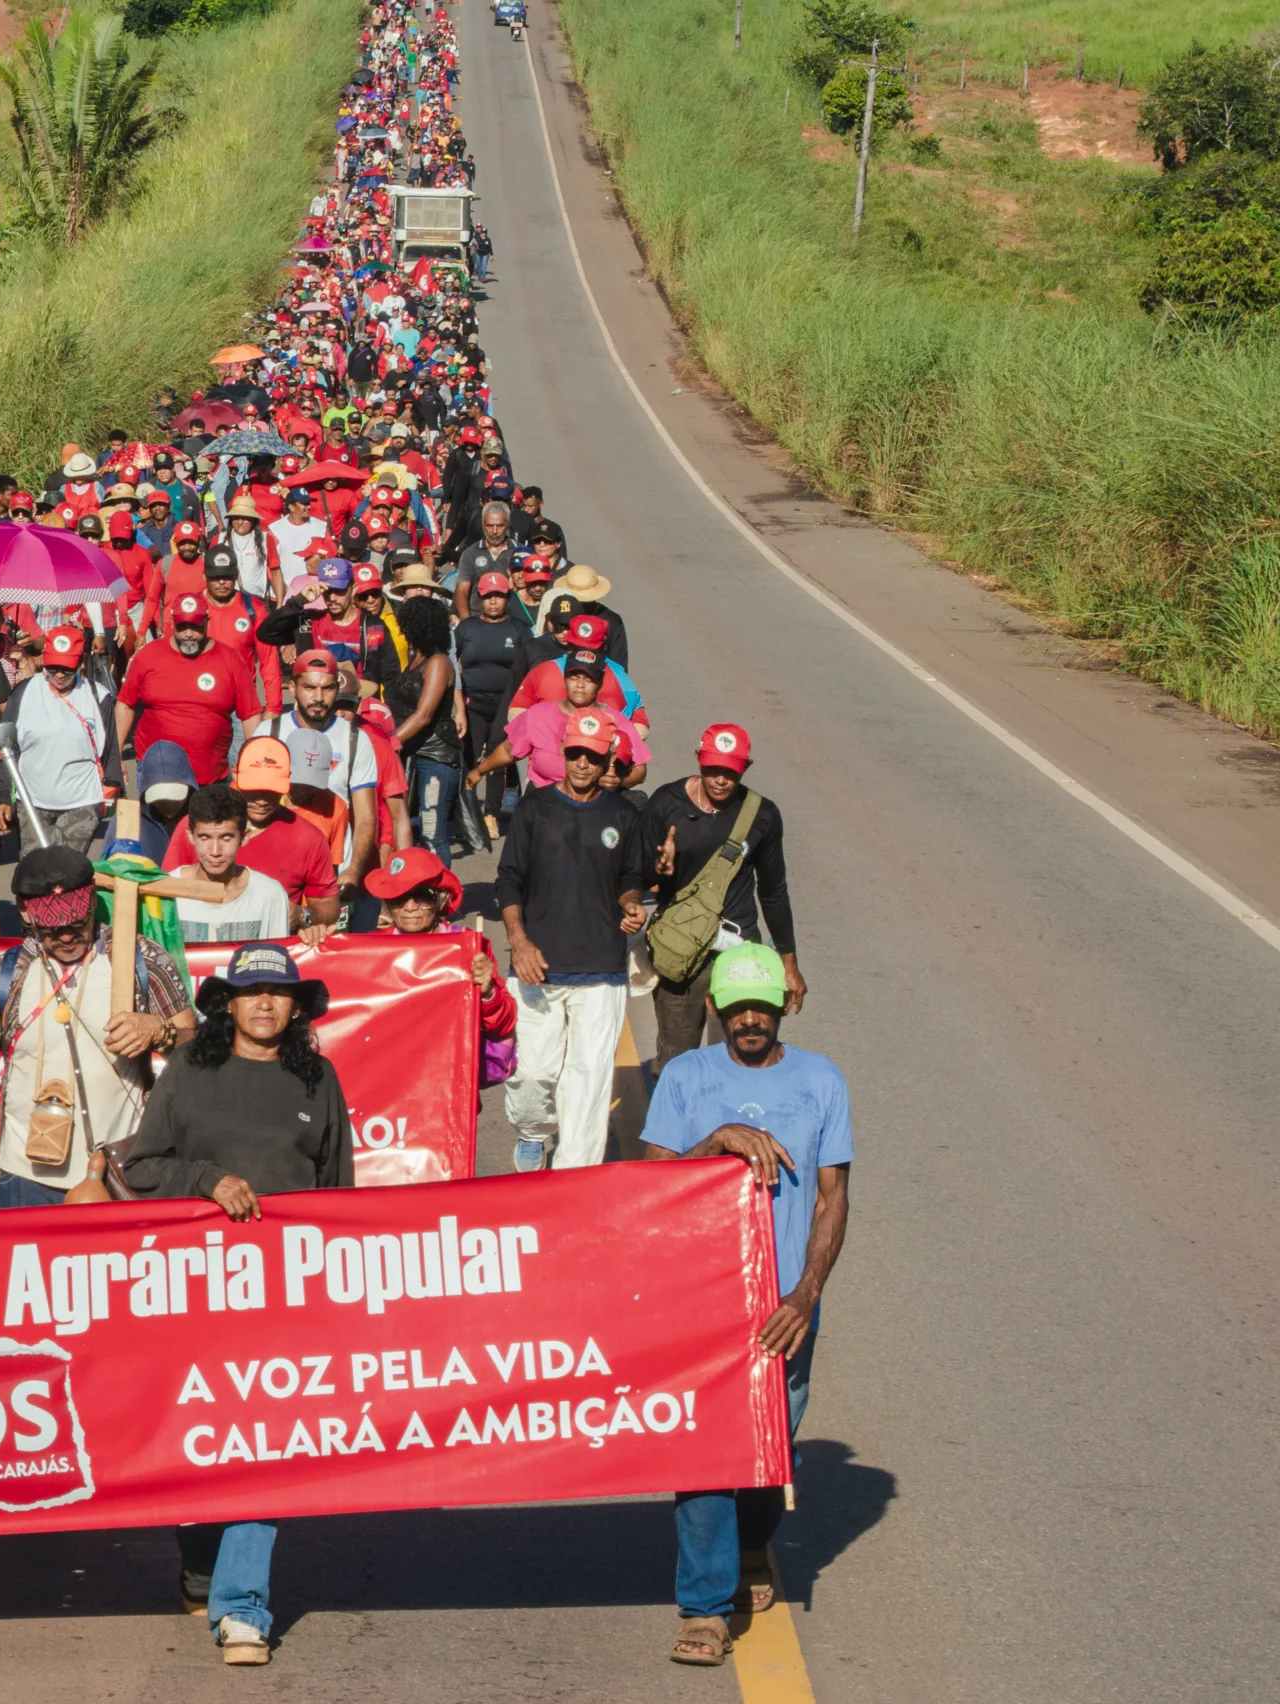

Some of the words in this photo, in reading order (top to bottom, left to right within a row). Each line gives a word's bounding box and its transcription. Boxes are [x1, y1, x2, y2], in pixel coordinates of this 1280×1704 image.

[4, 1231, 265, 1337] Agrária
[283, 1215, 539, 1315] Popular
[177, 1364, 215, 1404] A
[225, 1355, 335, 1402] VOZ
[352, 1346, 479, 1392] PELA
[486, 1337, 611, 1383] VIDA
[183, 1402, 386, 1467] CALARÁ
[397, 1411, 435, 1450] A
[446, 1386, 697, 1449] AMBIÇÃO!
